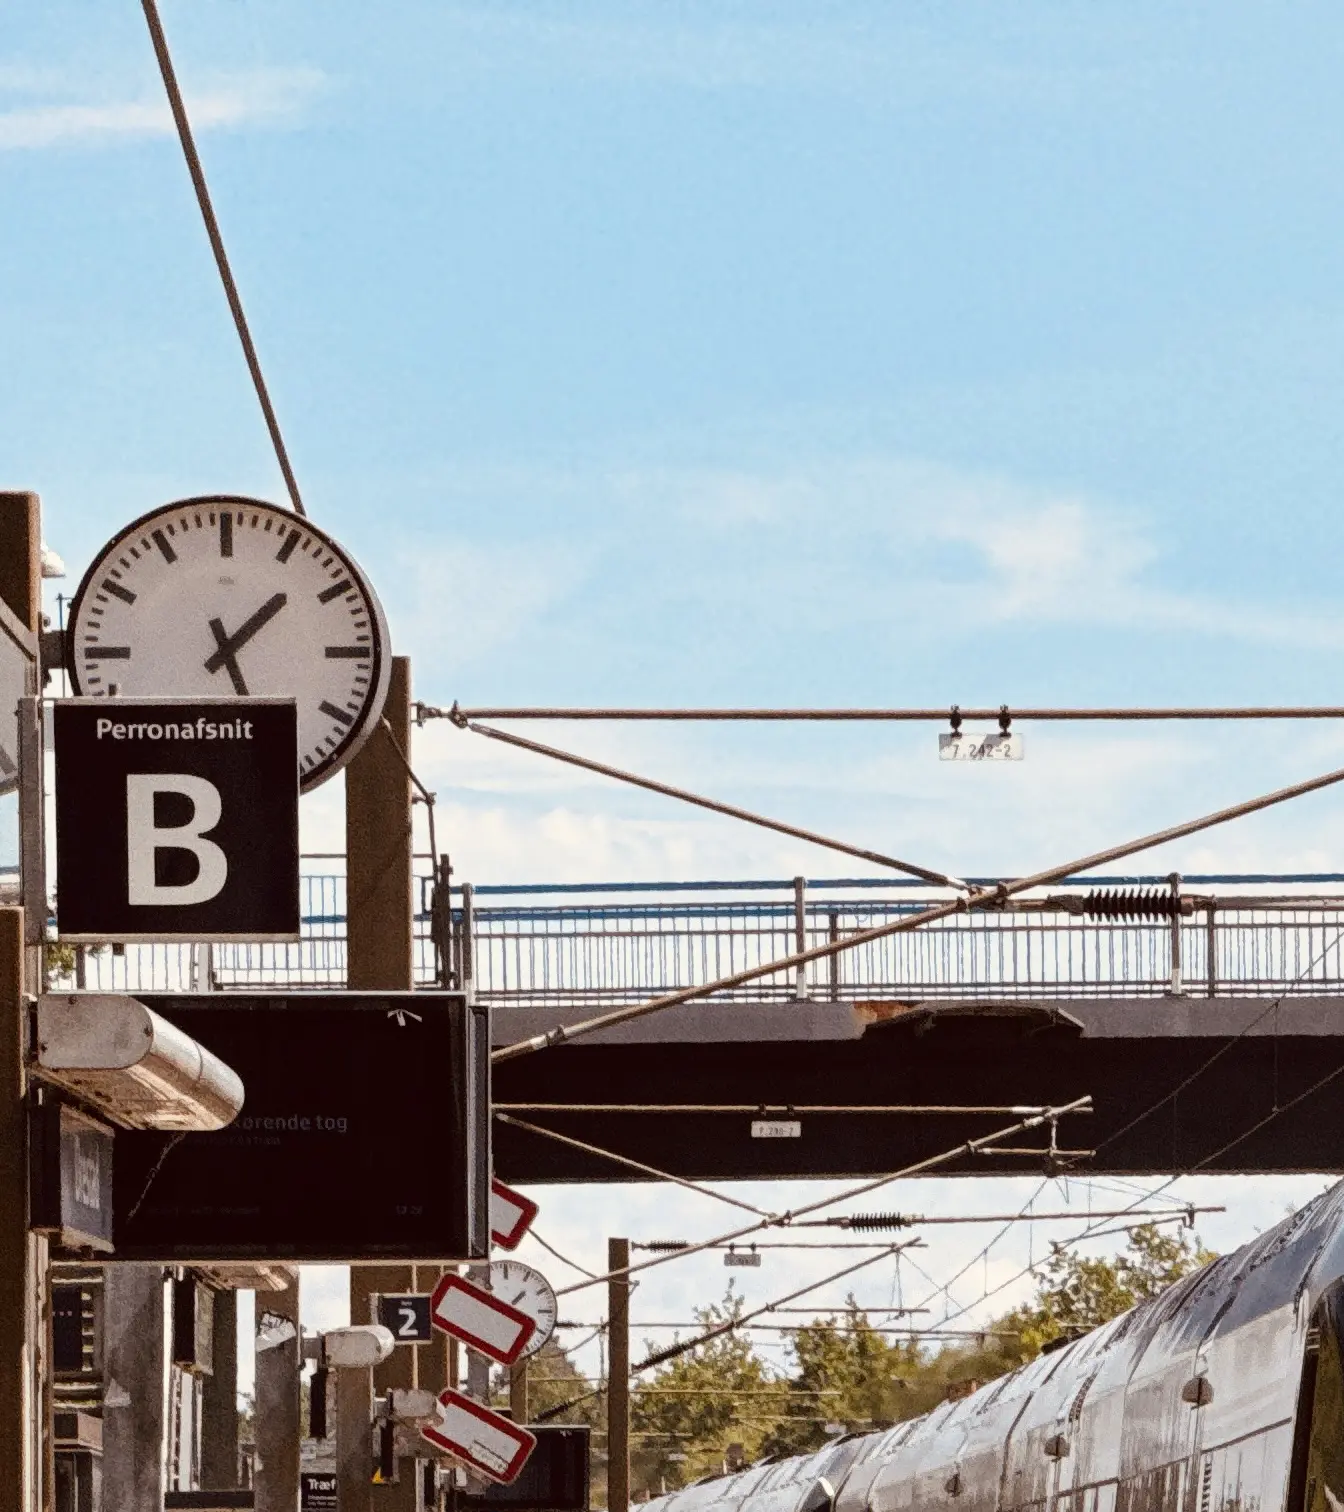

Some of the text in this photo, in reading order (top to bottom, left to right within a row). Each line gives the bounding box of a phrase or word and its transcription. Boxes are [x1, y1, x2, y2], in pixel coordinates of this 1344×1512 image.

[96, 716, 254, 740] Perronafsnit
[127, 774, 228, 905] B
[316, 1115, 347, 1134] tog
[398, 1308, 418, 1336] 2
